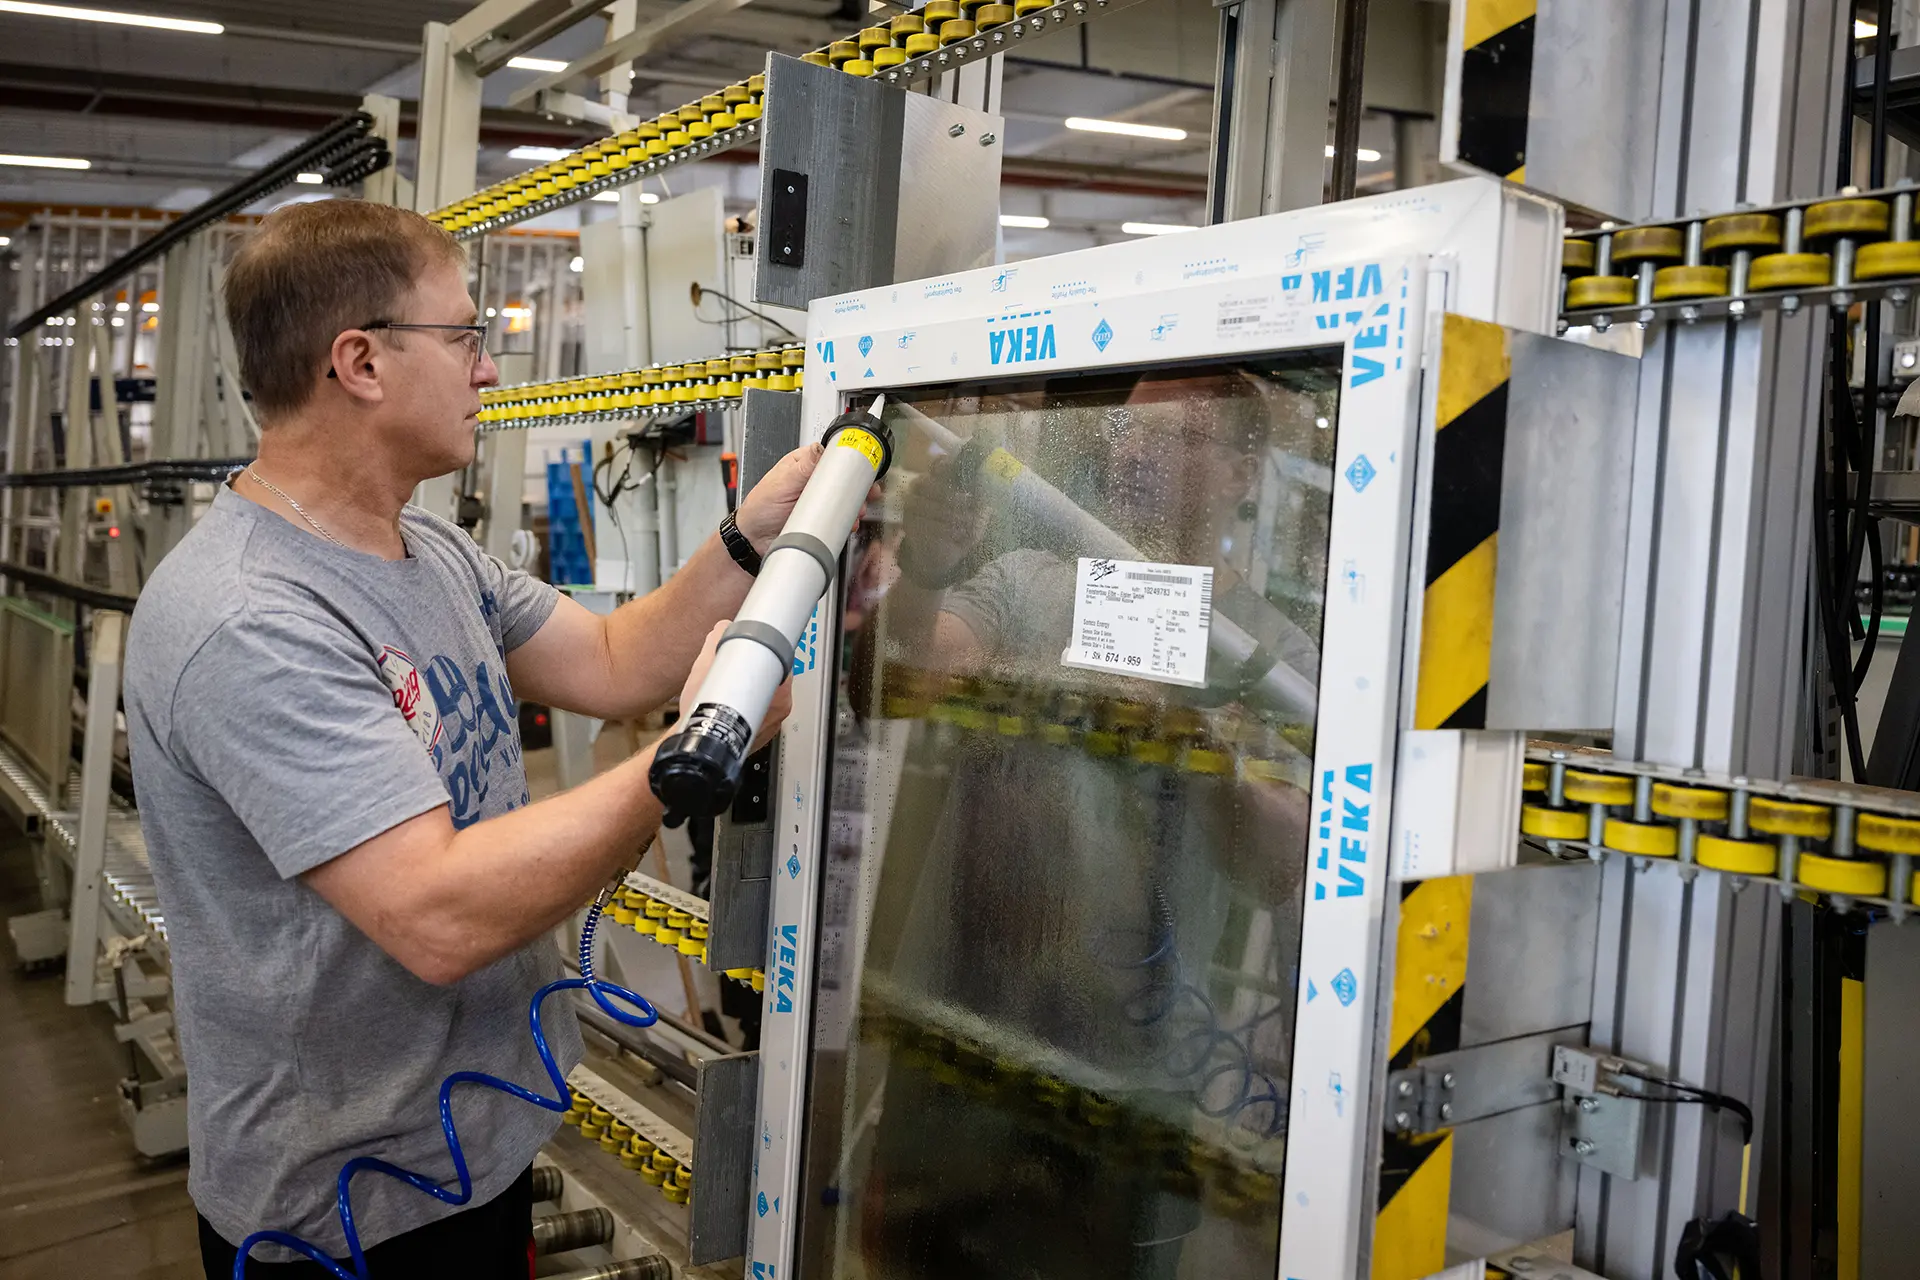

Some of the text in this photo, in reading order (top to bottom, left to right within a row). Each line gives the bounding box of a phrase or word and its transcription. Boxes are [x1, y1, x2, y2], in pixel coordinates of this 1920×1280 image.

[1051, 291, 1067, 300] Profile
[1069, 287, 1087, 297] Quality
[989, 324, 1057, 365] VEKA
[1084, 650, 1088, 658] 1
[1105, 652, 1120, 663] 674
[1127, 655, 1142, 667] 959
[1337, 763, 1373, 898] VEKA
[776, 924, 798, 1013] VEKA
